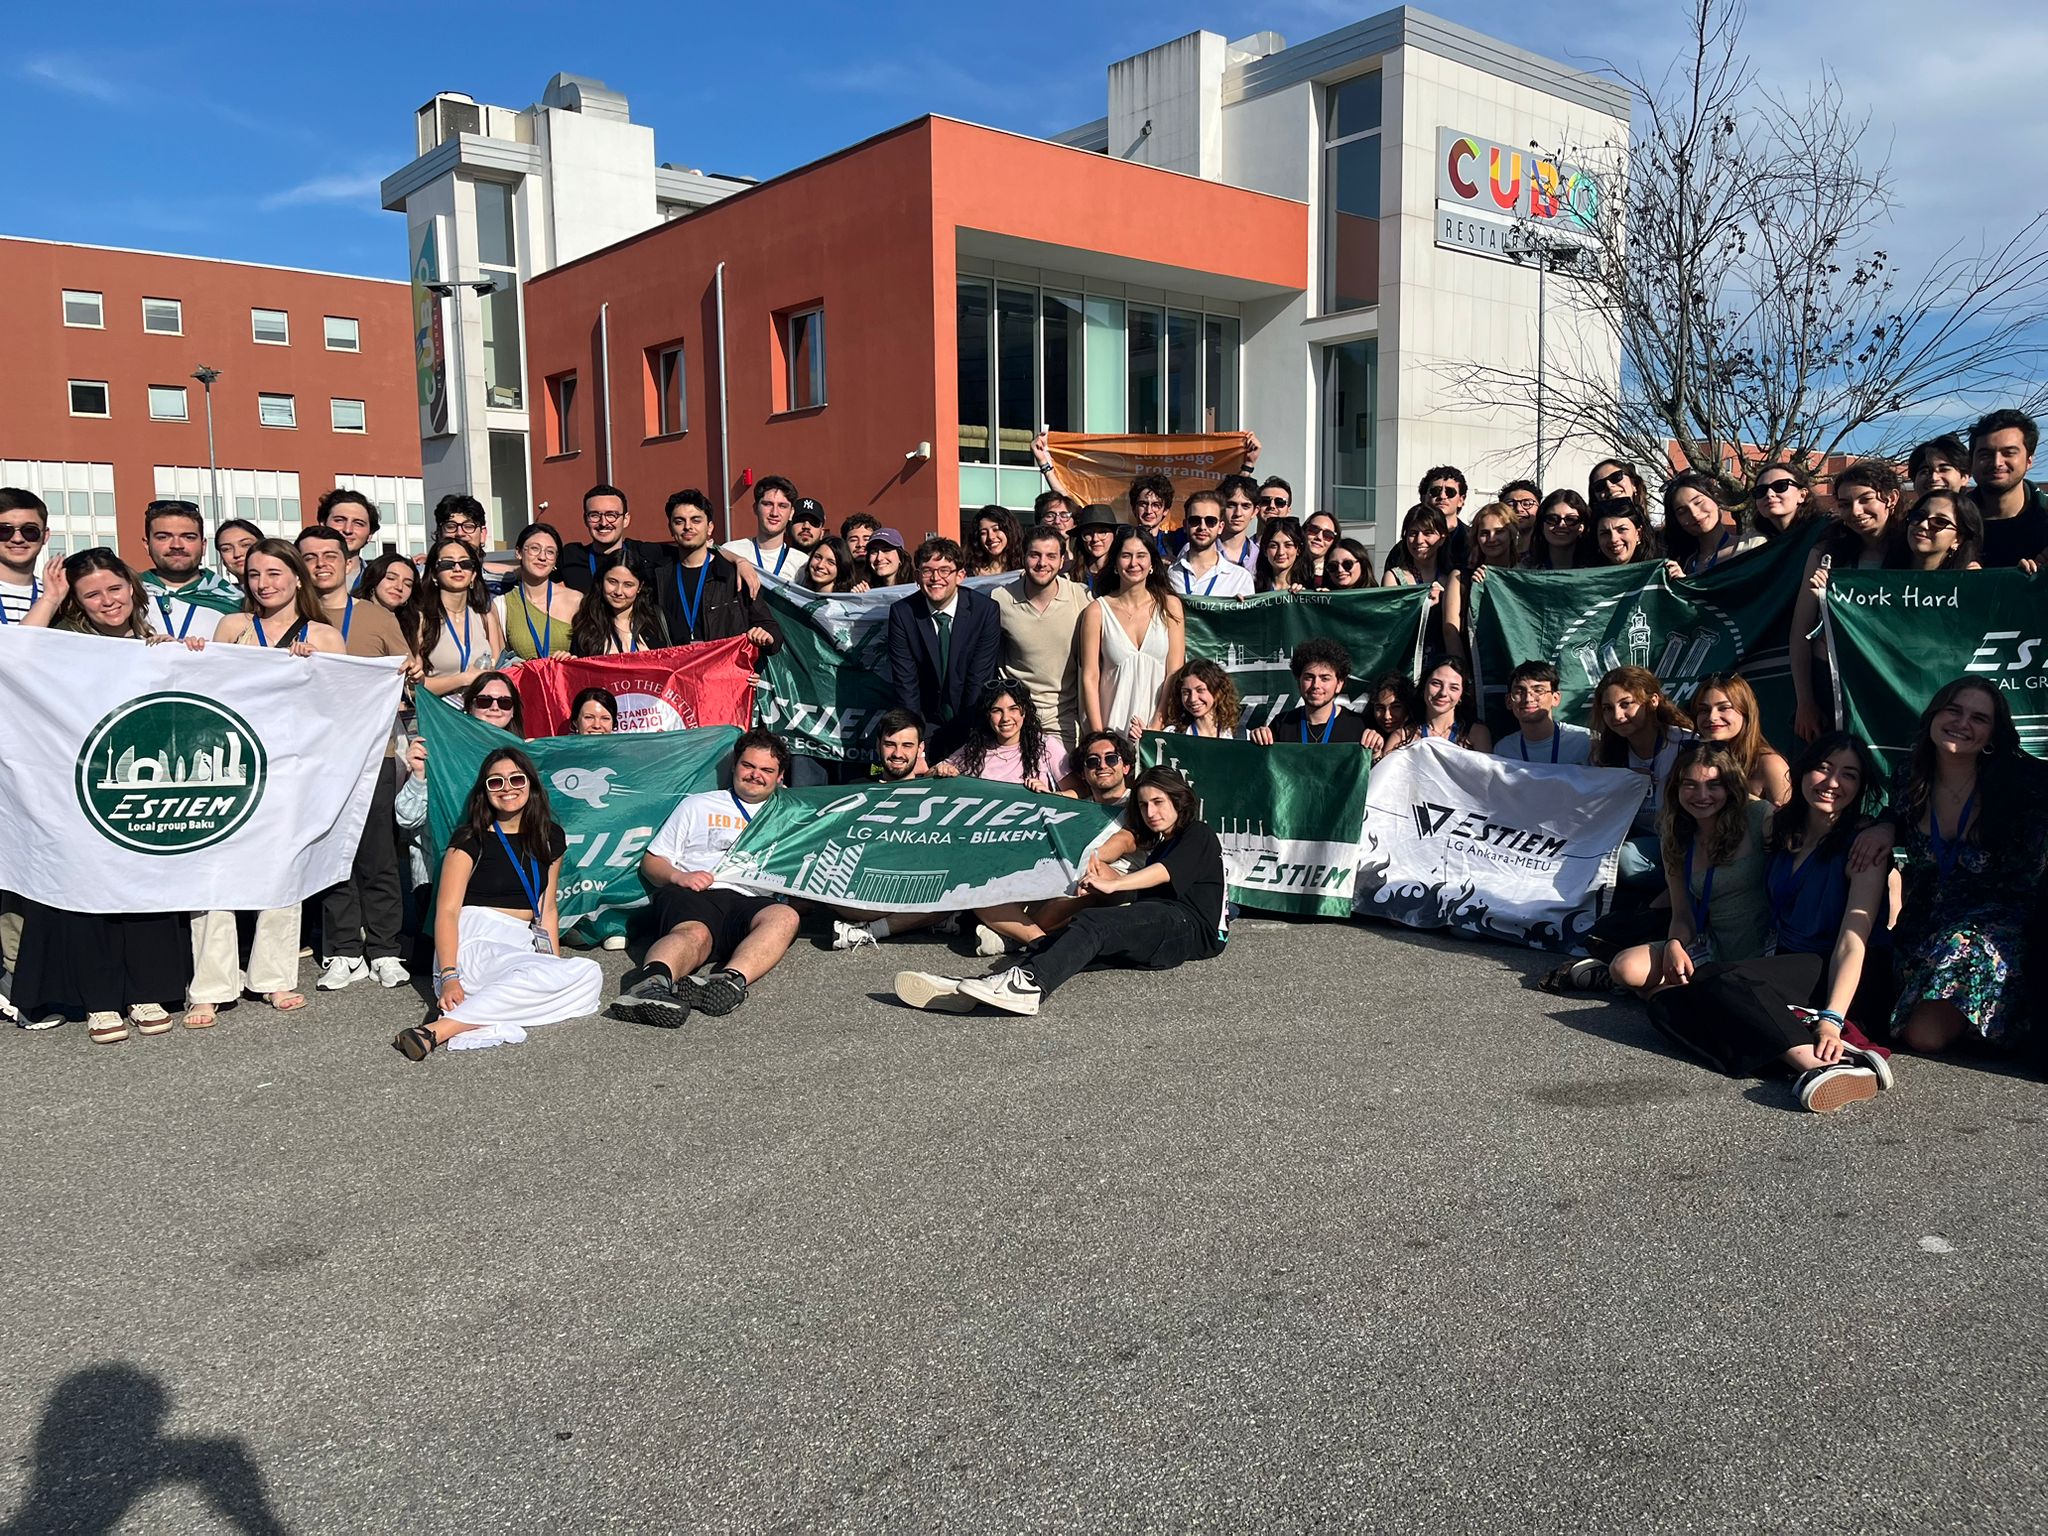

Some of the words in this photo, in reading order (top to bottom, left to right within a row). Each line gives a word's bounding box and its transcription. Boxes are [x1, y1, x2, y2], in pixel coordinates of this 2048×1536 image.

[1447, 137, 1598, 230] CUBO
[1219, 598, 1273, 611] TECHNICAL
[1275, 594, 1332, 605] UNIVERSITY
[1831, 582, 1891, 606] Work
[1902, 585, 1959, 608] Hard
[1964, 630, 2048, 672] ES
[611, 680, 631, 692] TO
[634, 679, 663, 694] THE
[1989, 677, 2021, 690] AL
[617, 707, 661, 720] STANBUL
[794, 737, 881, 761] ECONOM
[107, 794, 237, 820] ESTIEM
[127, 821, 156, 832] Local
[156, 821, 187, 833] group
[188, 819, 215, 829] Baku
[708, 813, 731, 828] LED
[846, 825, 873, 840] LG
[875, 829, 951, 844] ANKARA
[1446, 838, 1464, 852] LG
[1450, 812, 1569, 858] ESTIEM
[1245, 854, 1351, 890] ESTIEM
[556, 879, 608, 902] OSCOW
